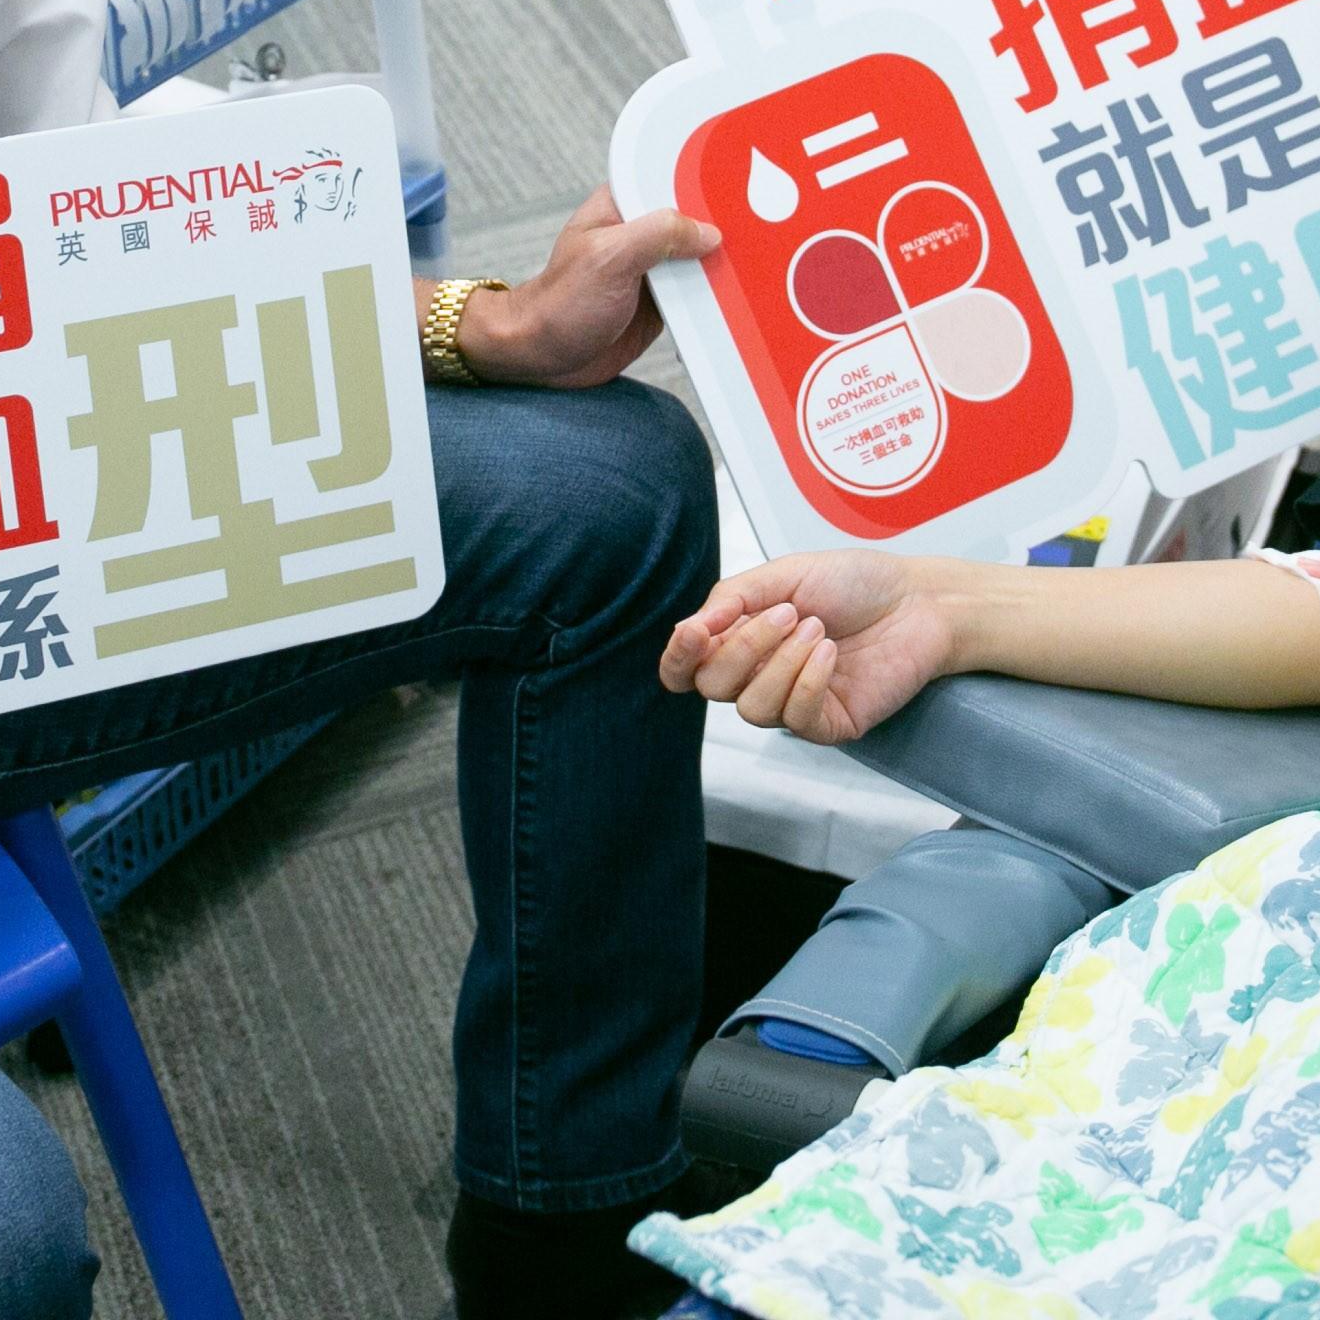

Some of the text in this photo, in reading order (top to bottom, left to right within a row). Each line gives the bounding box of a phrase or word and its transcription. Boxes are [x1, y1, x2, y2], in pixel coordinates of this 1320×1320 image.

[49, 159, 275, 227] PRUDENTIAL
[55, 198, 279, 267] 英國保誠
[816, 378, 921, 430] SAVES THREE LIVES
[827, 371, 897, 410] DONATION
[841, 364, 872, 386] ONE
[63, 262, 419, 661] 型
